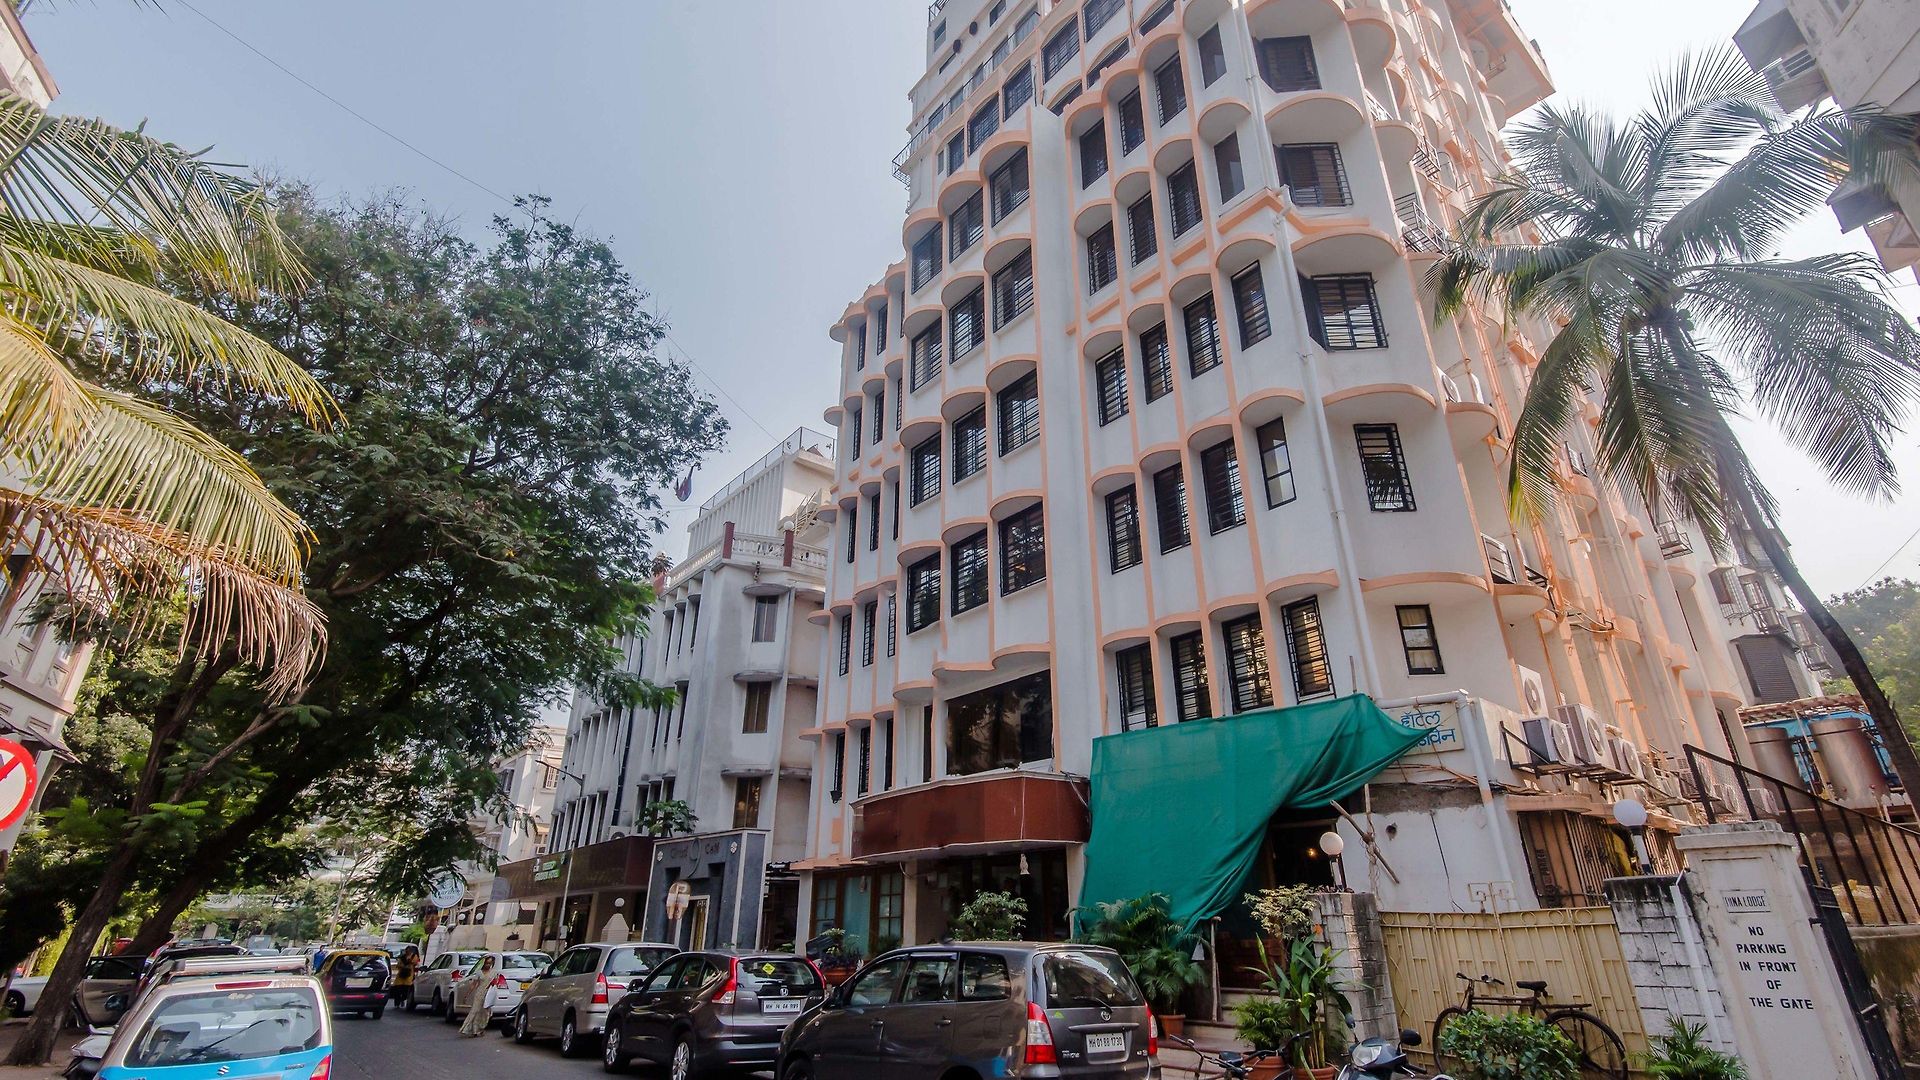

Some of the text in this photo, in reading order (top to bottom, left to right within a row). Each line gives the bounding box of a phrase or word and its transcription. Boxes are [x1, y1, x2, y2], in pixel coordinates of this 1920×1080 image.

[1748, 926, 1764, 936] NO
[1736, 943, 1787, 954] PARKING
[1739, 961, 1797, 972] IN FRONT
[1766, 979, 1782, 990] OF
[1749, 997, 1814, 1010] THE GATE
